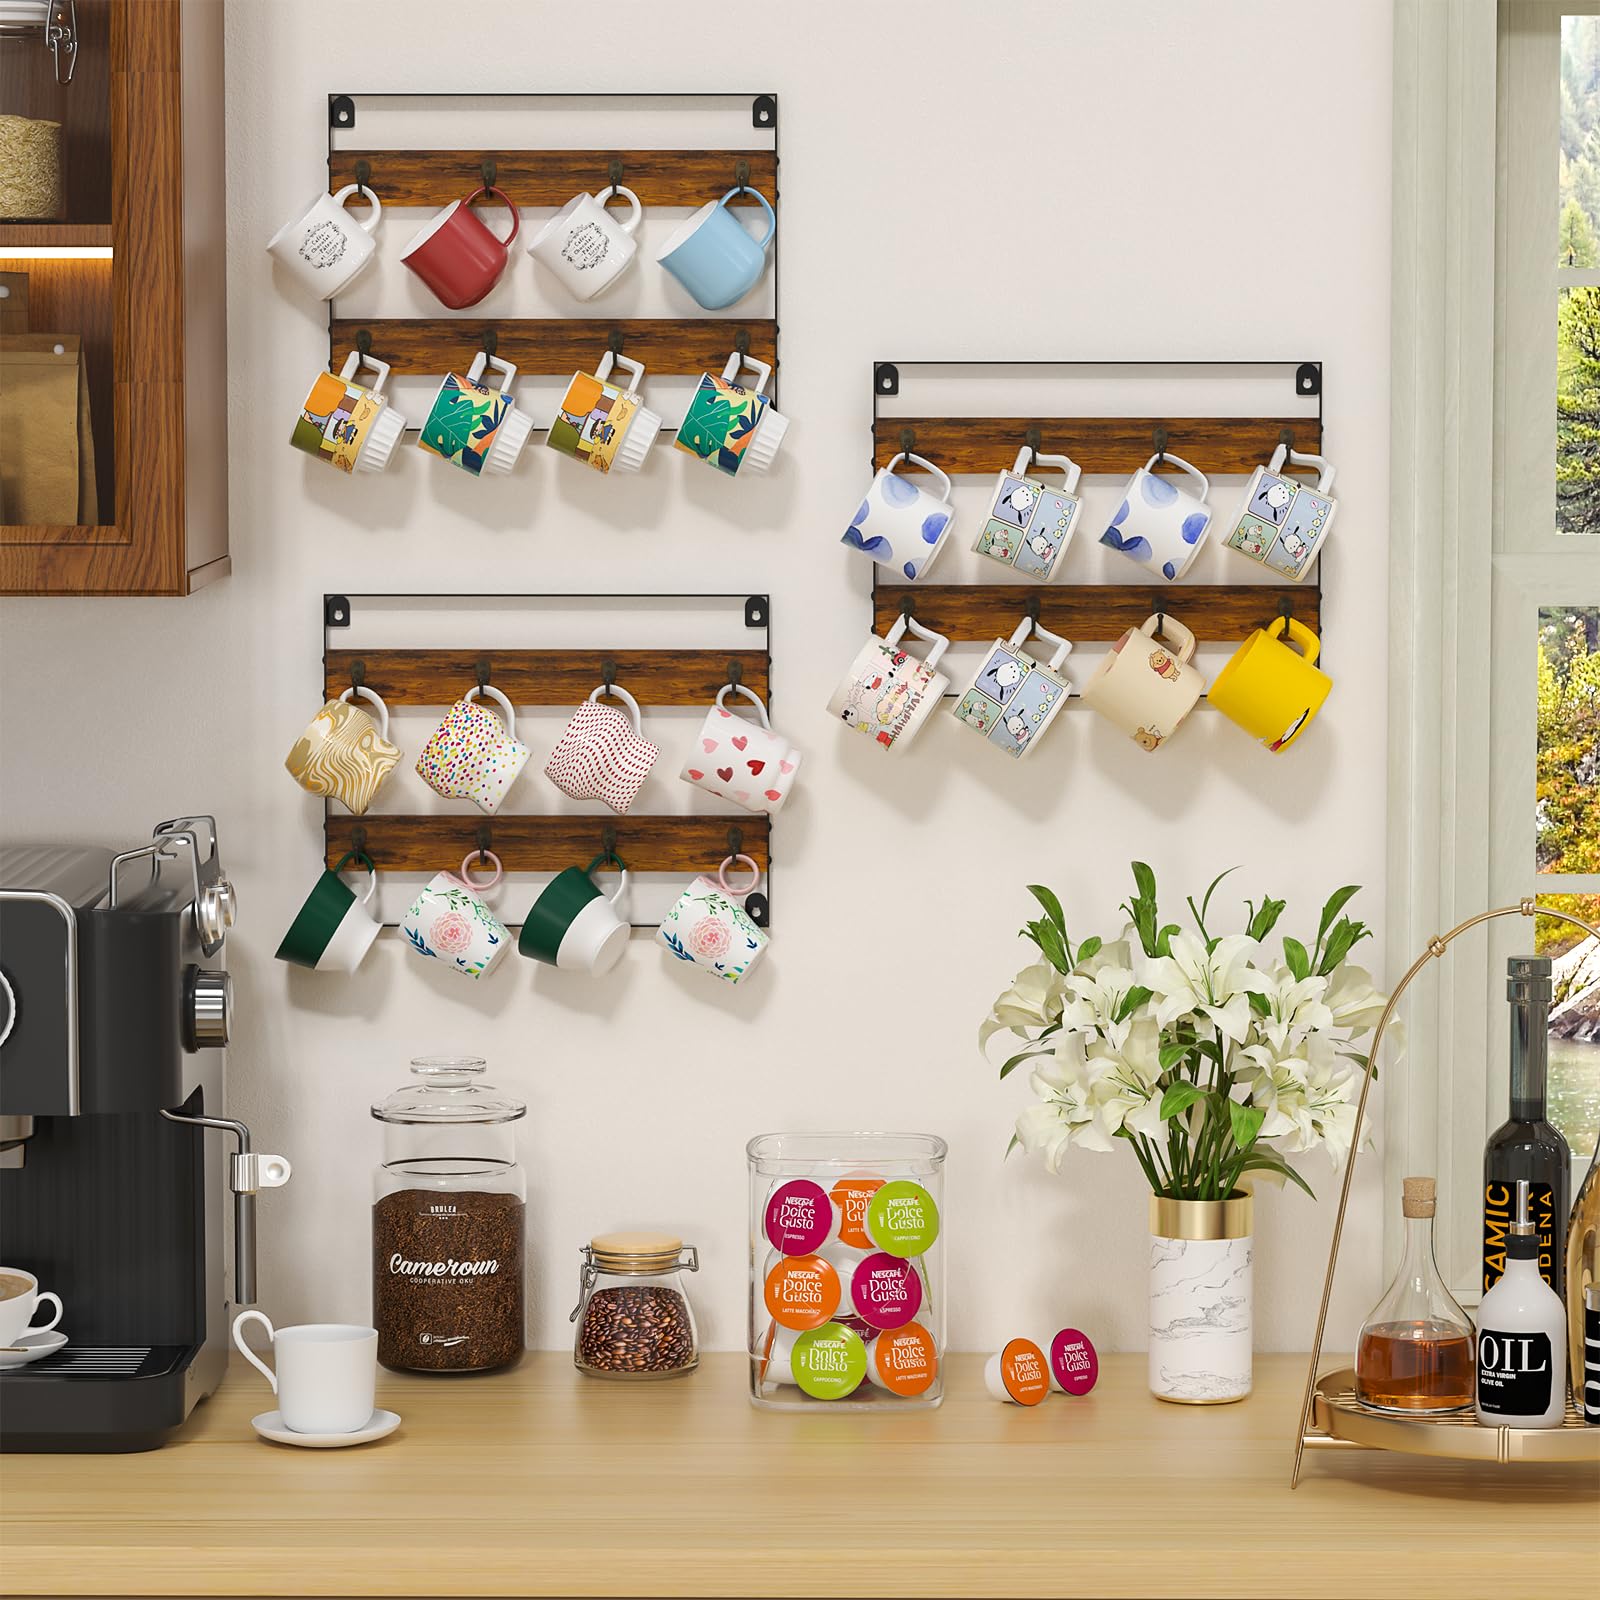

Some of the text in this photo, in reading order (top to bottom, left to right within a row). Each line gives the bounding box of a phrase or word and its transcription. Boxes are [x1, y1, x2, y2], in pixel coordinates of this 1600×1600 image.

[781, 1204, 815, 1219] Dolce
[887, 1206, 923, 1220] Dolce
[780, 1216, 814, 1230] Gusto
[888, 1218, 925, 1230] Gusto
[390, 1253, 499, 1277] Cameroun
[410, 1277, 457, 1285] COOPERATIVE
[783, 1279, 822, 1293] Dolce
[869, 1278, 906, 1292] Dolce
[783, 1290, 822, 1303] Gusto
[871, 1288, 908, 1302] Gusto
[809, 1348, 848, 1363] Dolce
[891, 1345, 925, 1361] Dolce
[1064, 1350, 1088, 1363] Dolce
[1480, 1335, 1547, 1372] OIL
[809, 1359, 848, 1372] Gusto
[893, 1357, 927, 1370] Gusto
[1014, 1360, 1039, 1373] Dolce
[1066, 1360, 1091, 1372] Gusto
[1017, 1370, 1042, 1383] Gusto
[1481, 1369, 1516, 1380] EXTRA VIRGIN
[1481, 1377, 1494, 1386] OLIVE
